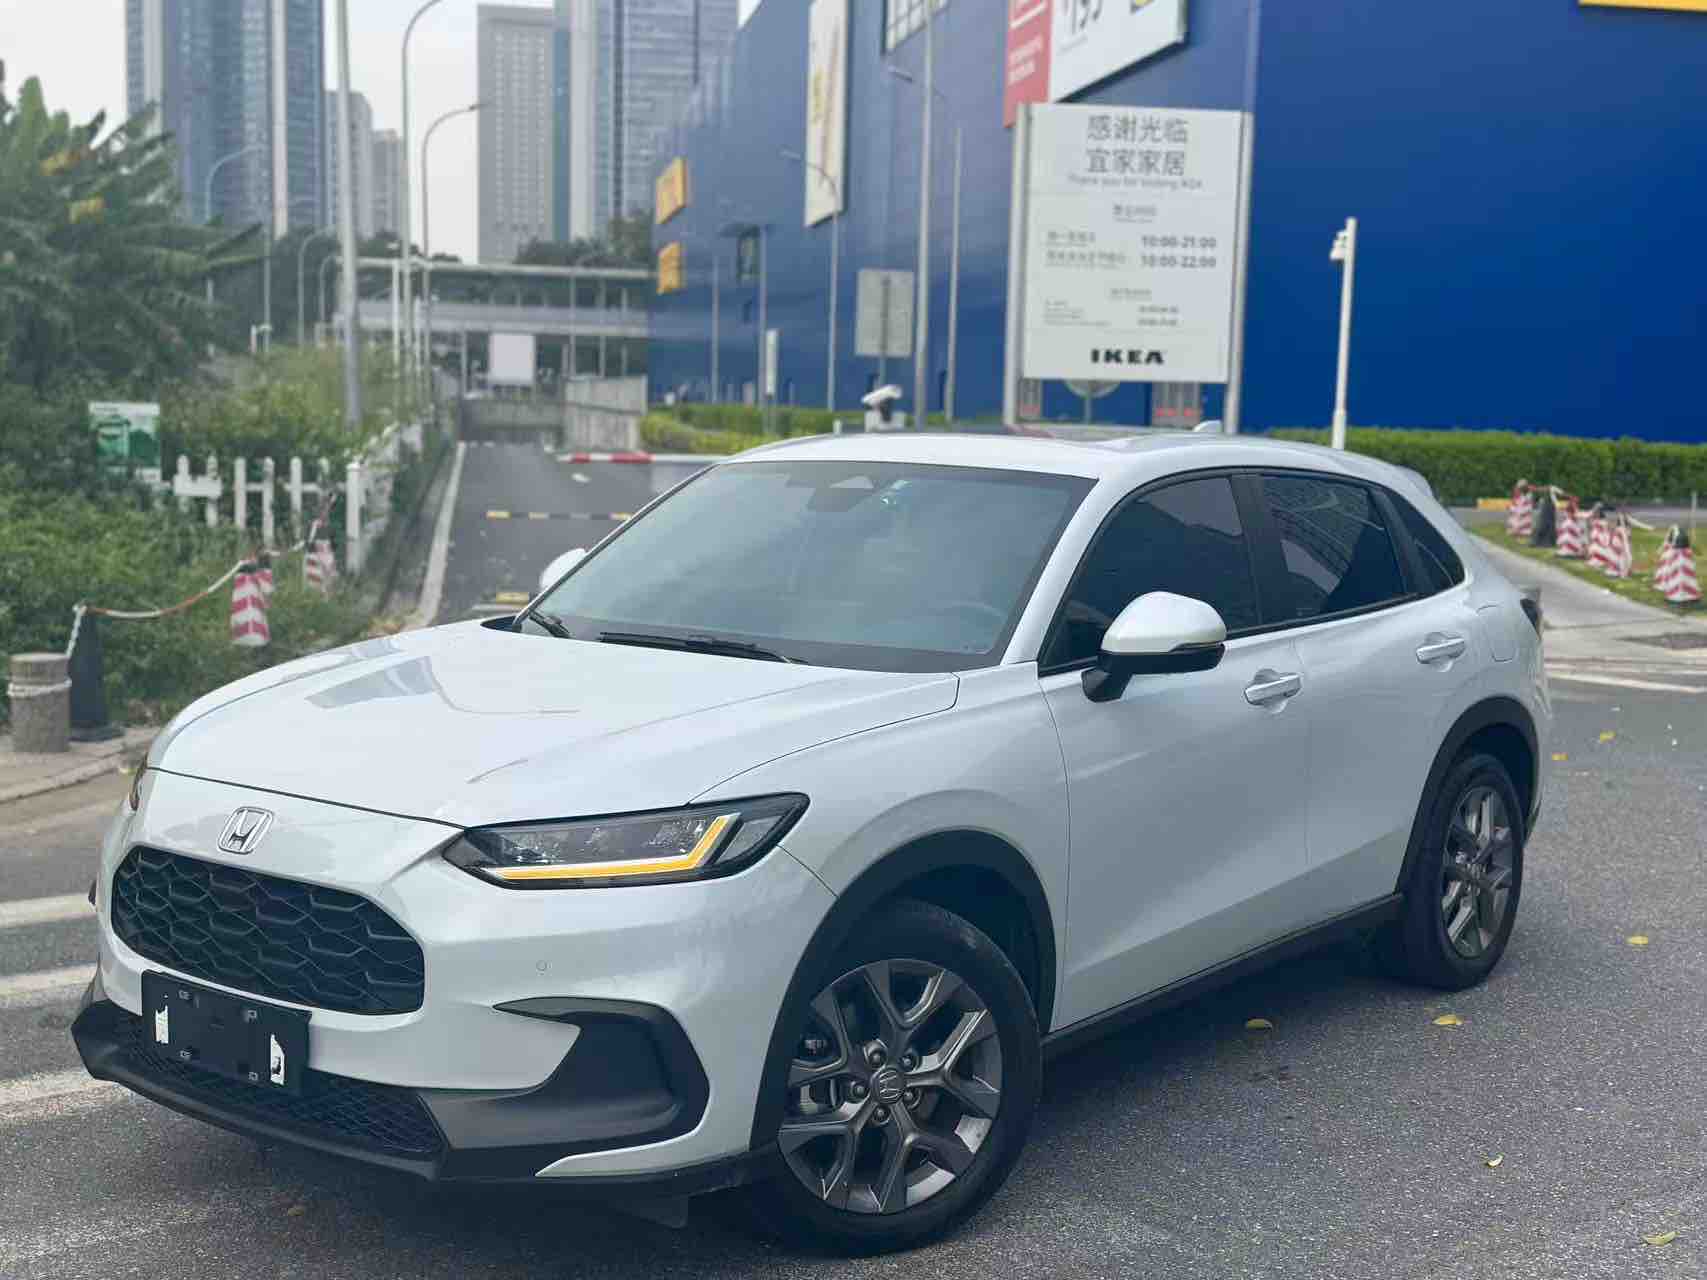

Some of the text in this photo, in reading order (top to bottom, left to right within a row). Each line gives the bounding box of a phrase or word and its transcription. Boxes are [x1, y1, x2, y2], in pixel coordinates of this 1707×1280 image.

[1086, 148, 1186, 176] 宜家家居
[1091, 349, 1165, 364] IKEA
